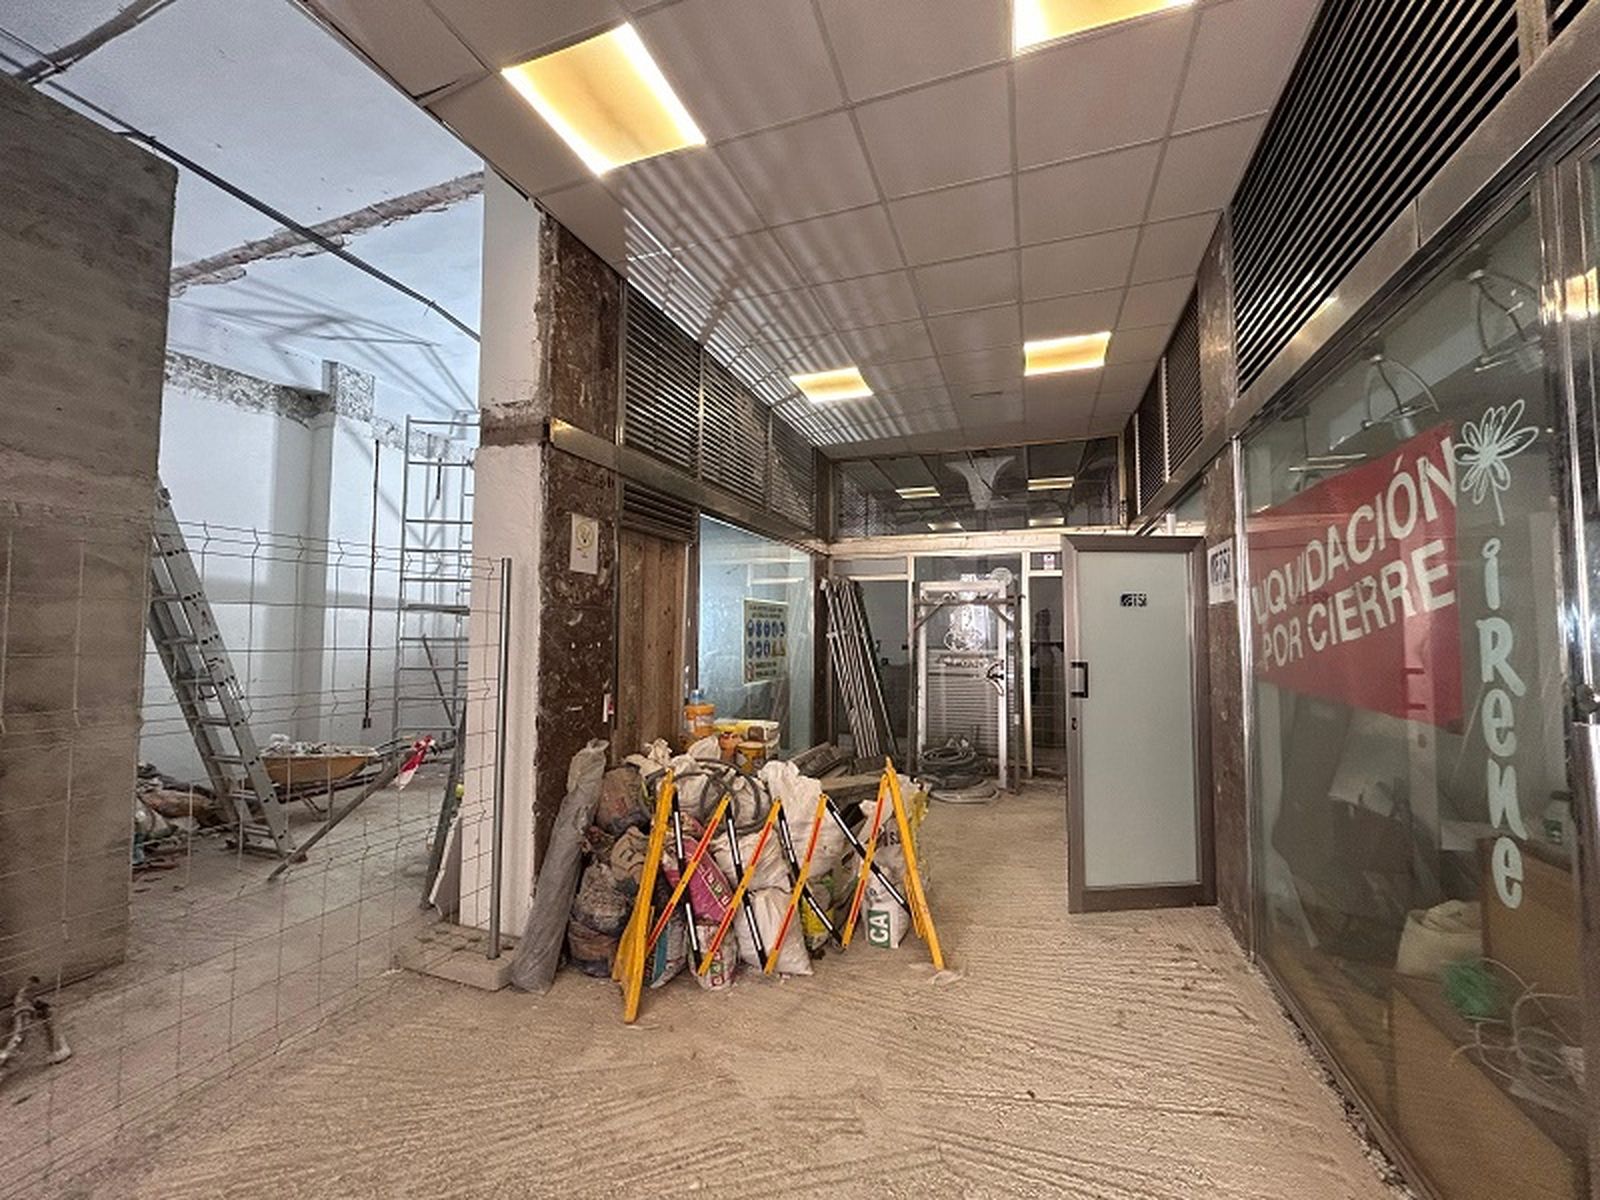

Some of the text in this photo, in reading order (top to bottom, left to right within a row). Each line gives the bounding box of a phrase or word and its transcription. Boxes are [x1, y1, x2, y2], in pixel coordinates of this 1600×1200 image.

[1251, 436, 1457, 625] LIQUIDACIÓN
[1261, 538, 1456, 672] POR CIERRE
